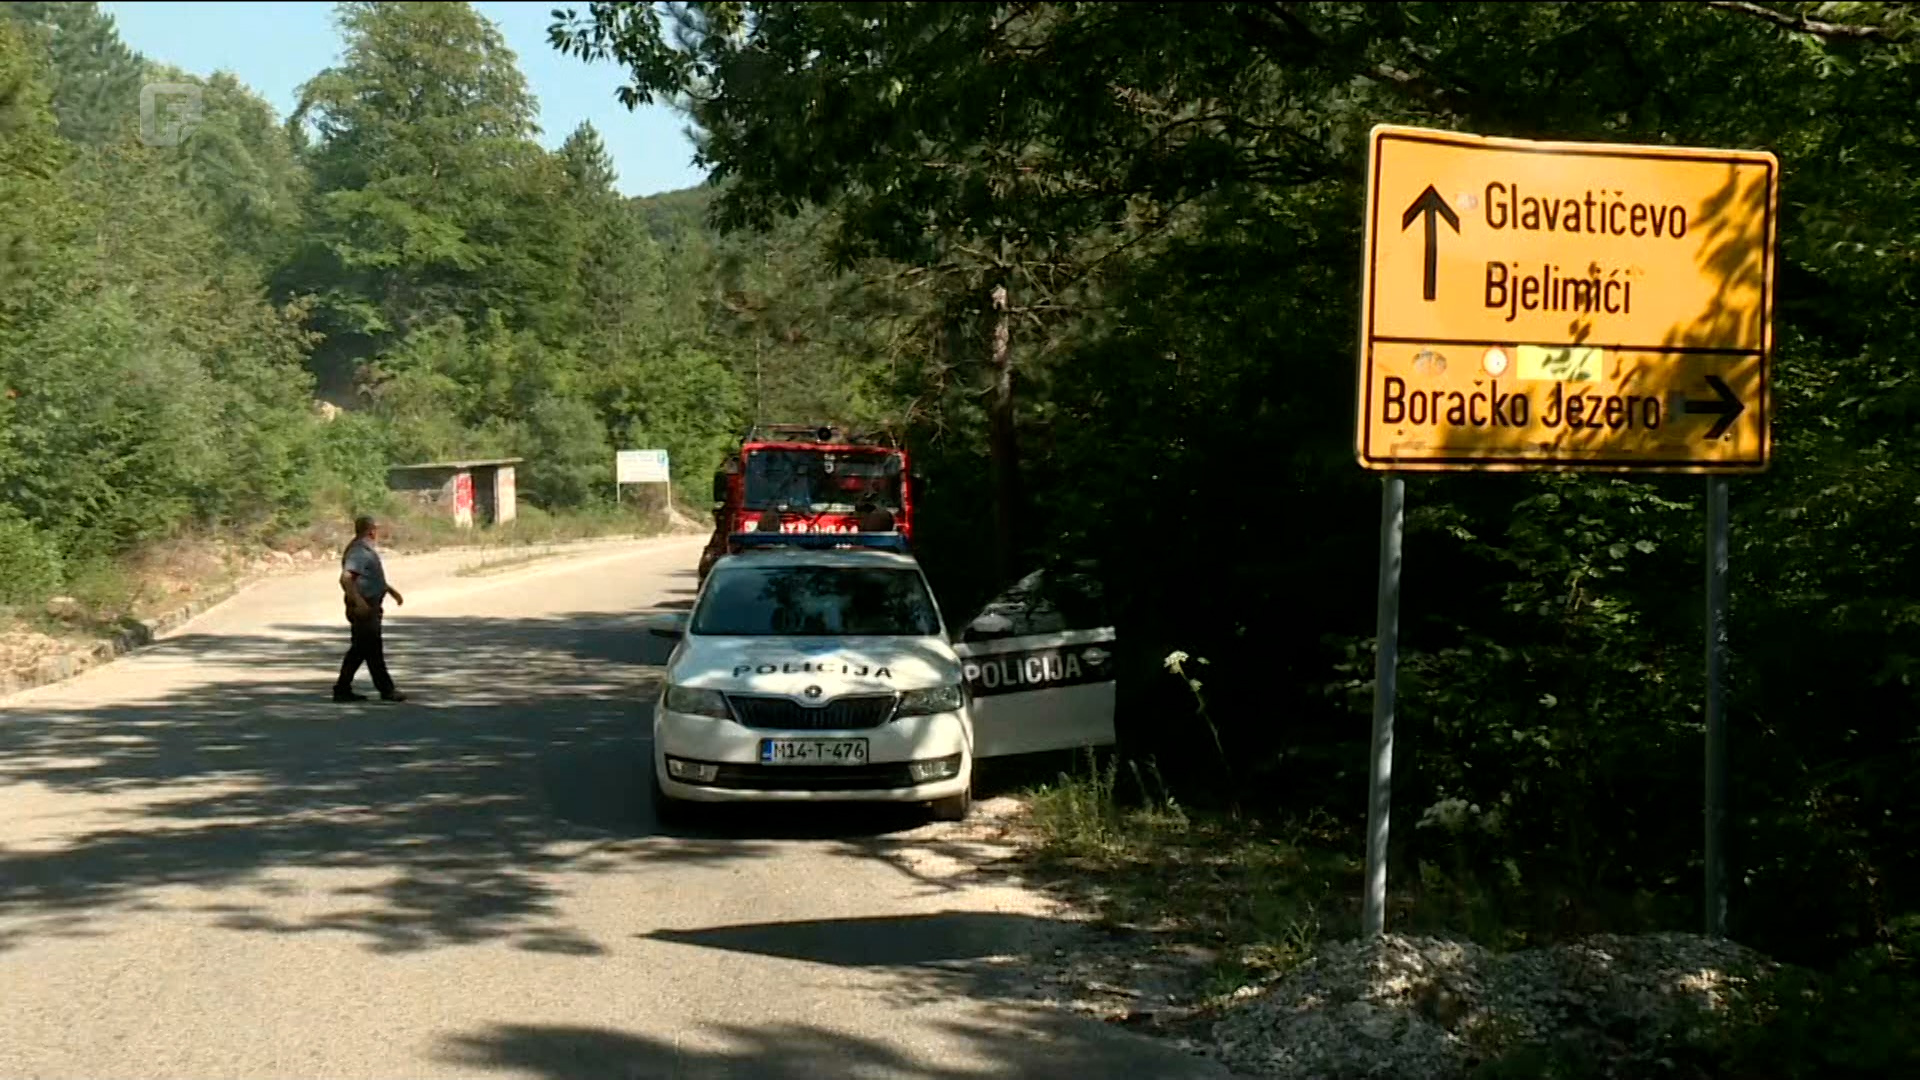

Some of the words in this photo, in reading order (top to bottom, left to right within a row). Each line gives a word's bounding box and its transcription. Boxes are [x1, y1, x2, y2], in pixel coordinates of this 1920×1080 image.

[1485, 181, 1687, 239] Glavatičevo
[1485, 262, 1630, 322] Bjelimići
[1382, 376, 1529, 426] Boračko
[1541, 381, 1660, 430] Jezero
[733, 662, 893, 679] POLICIJA
[963, 653, 1082, 688] POLICIJA
